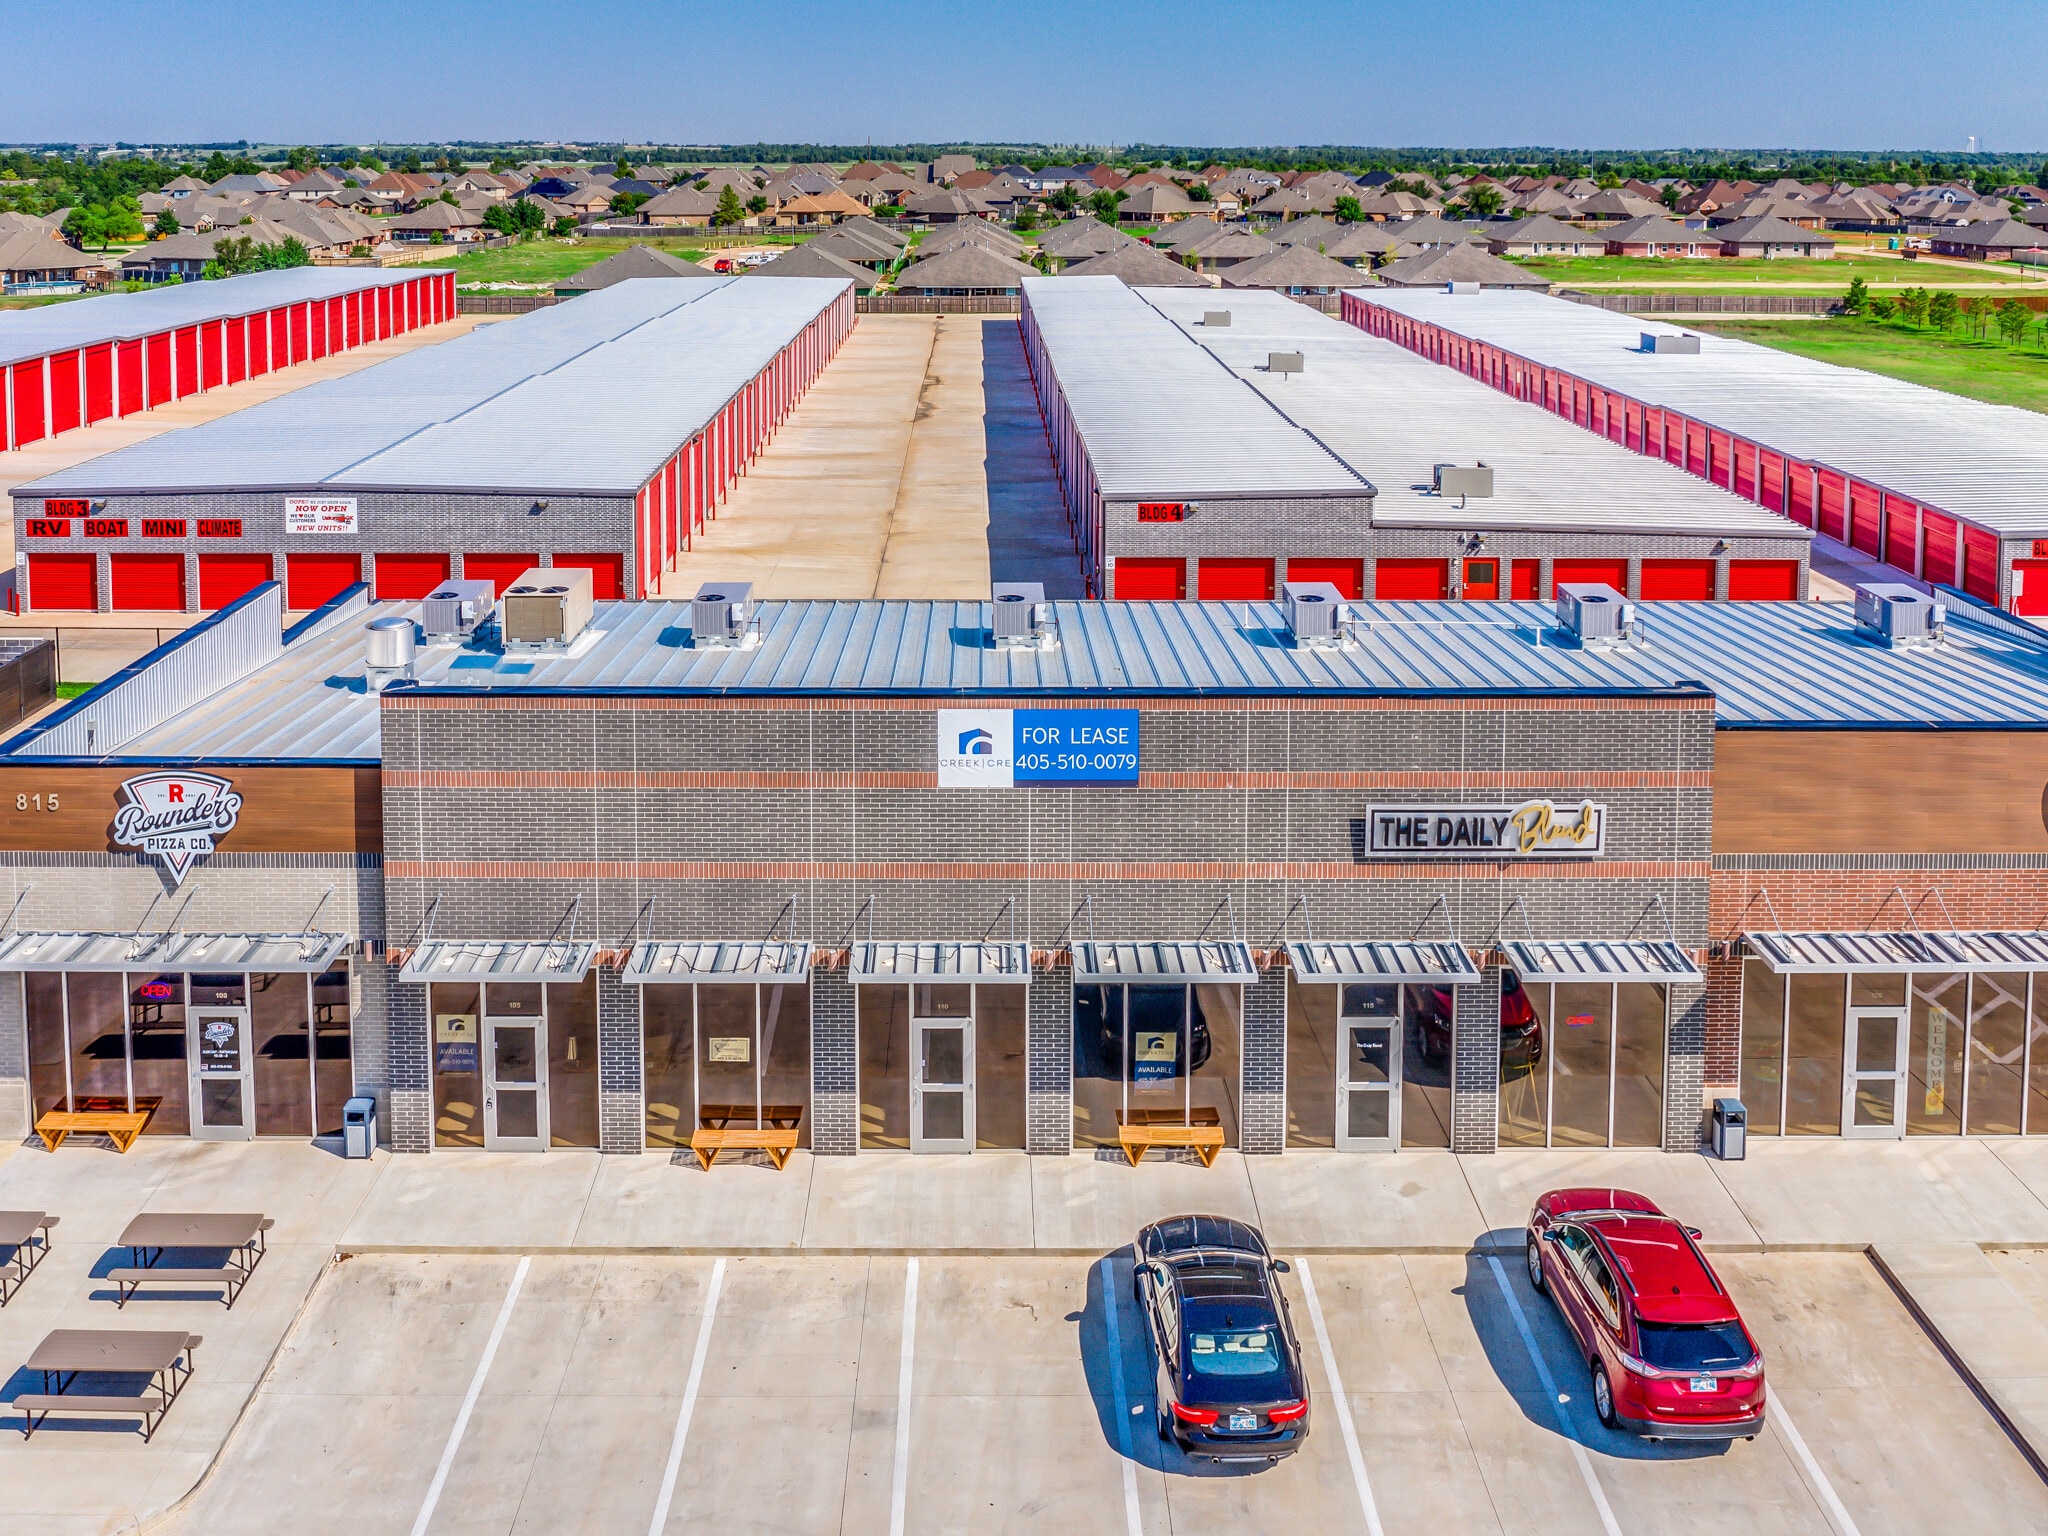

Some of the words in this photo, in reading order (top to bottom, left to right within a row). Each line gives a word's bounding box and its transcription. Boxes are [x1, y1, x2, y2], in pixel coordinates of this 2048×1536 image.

[46, 502, 74, 516] BLDG
[77, 501, 88, 517] 3
[1139, 506, 1168, 520] BLDG
[1170, 505, 1182, 521] 4
[32, 521, 63, 536] RV
[86, 521, 126, 536] BOAT
[145, 521, 183, 535] MINI
[199, 521, 240, 535] CLIMATE
[1022, 727, 1060, 745] FOR
[1070, 727, 1129, 745] LEASE
[1015, 753, 1137, 770] 405-510-0079
[168, 784, 185, 803] R
[16, 793, 60, 812] 815
[1379, 816, 1428, 848] THE
[1436, 816, 1509, 848] DAILY
[1512, 804, 1595, 854] Blend
[148, 838, 186, 850] PIZZA
[191, 838, 211, 850] CO.
[141, 984, 173, 997] OPEN
[1566, 1015, 1595, 1026] OPEN
[1930, 1014, 1944, 1090] WELCOME
